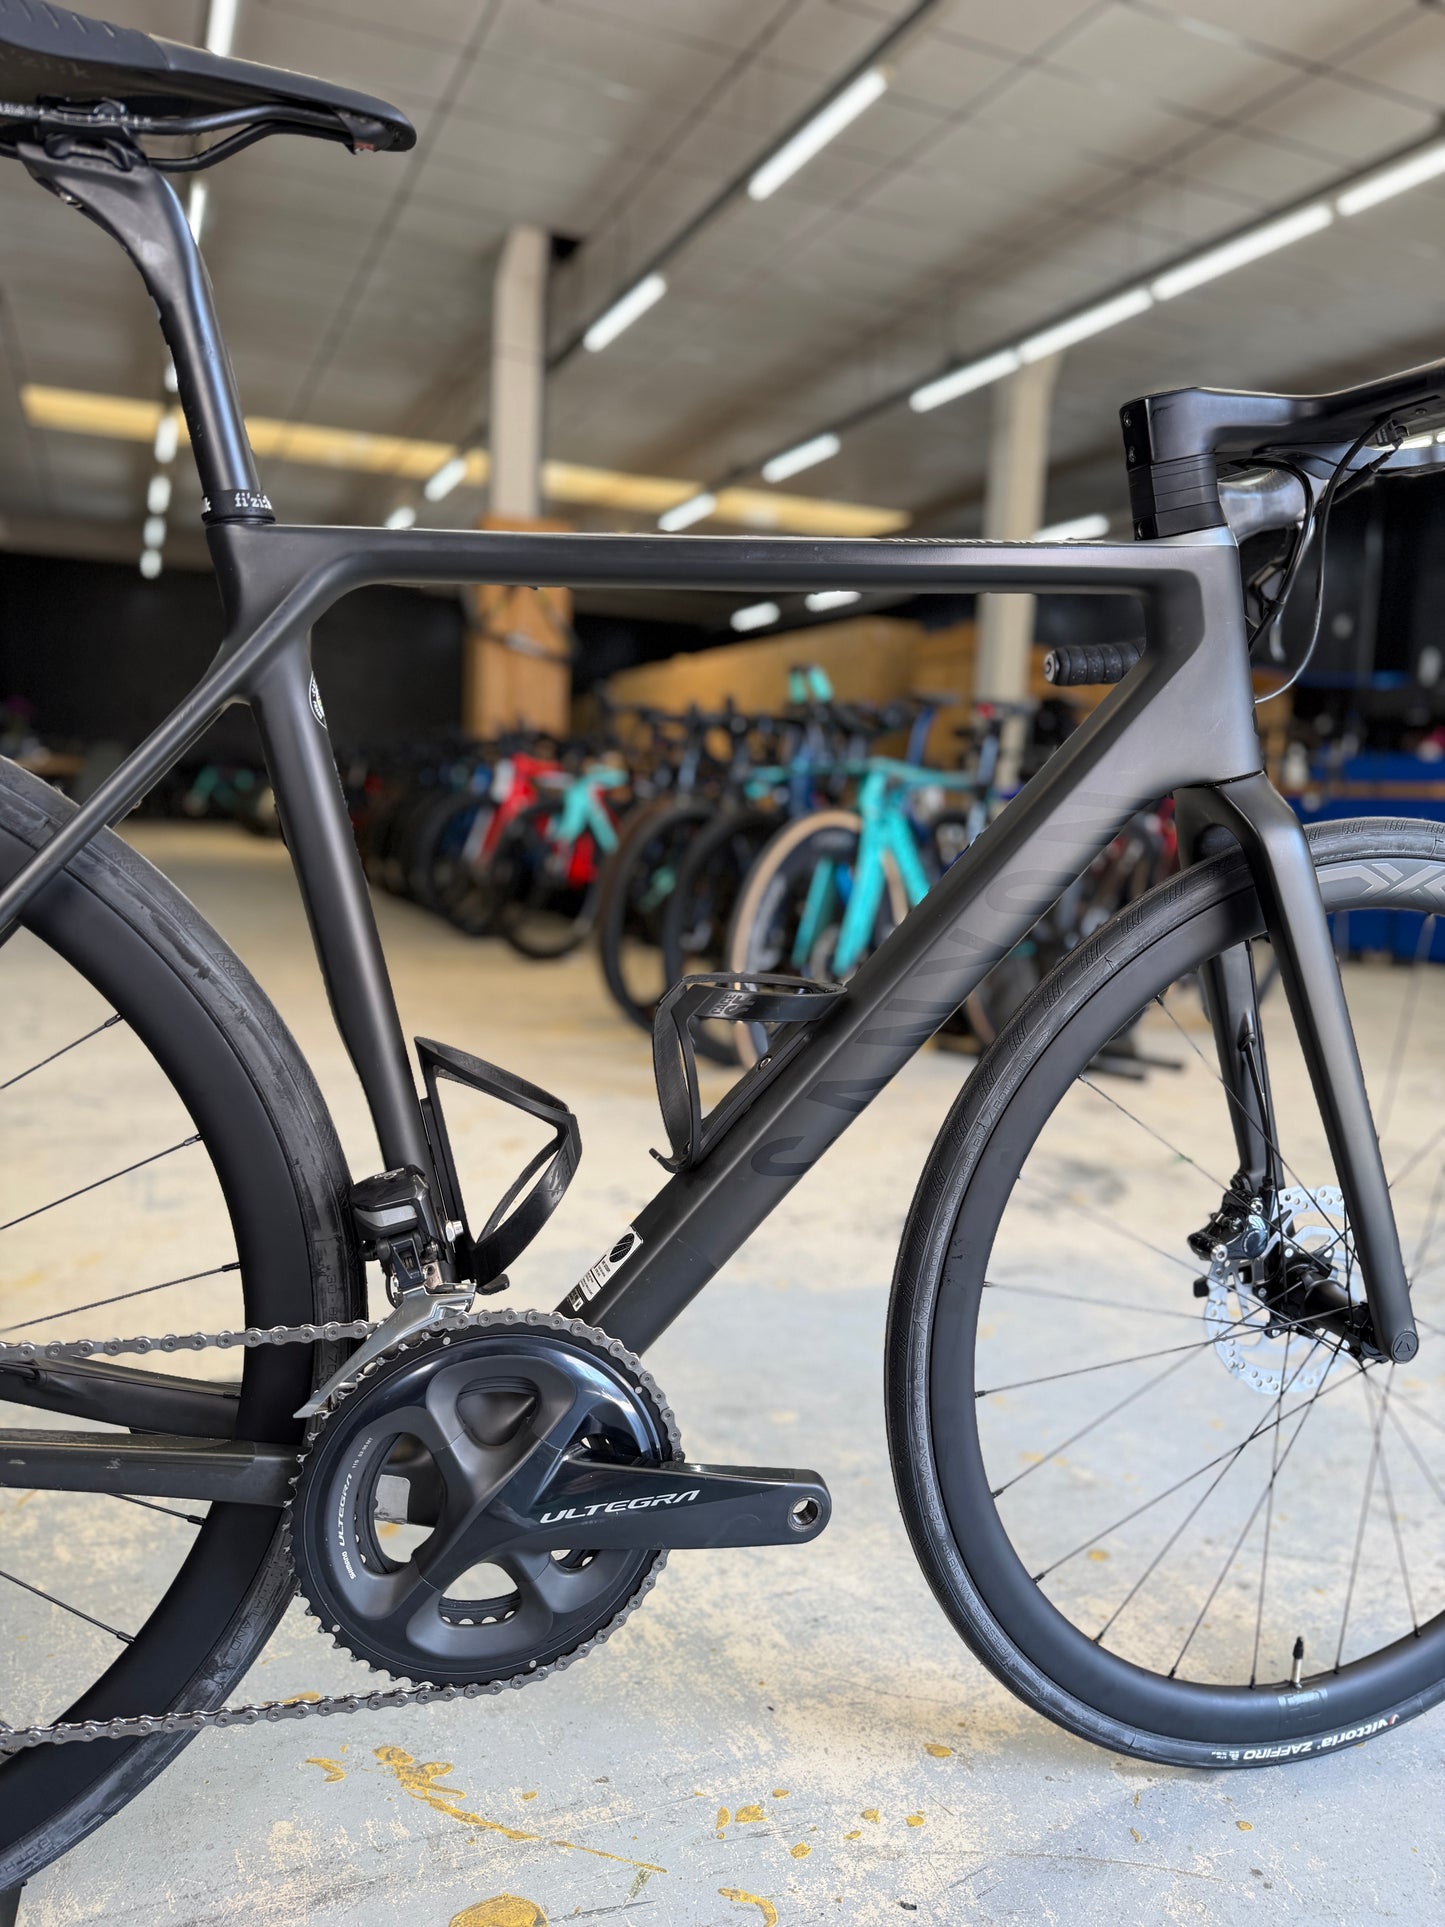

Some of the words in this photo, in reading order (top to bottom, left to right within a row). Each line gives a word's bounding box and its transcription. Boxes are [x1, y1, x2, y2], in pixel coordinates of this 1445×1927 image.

[948, 1149, 977, 1204] HOOKED
[992, 1050, 1035, 1110] ROTATION
[337, 1473, 353, 1547] ULTEGRA
[539, 1489, 701, 1524] ULTEGRA
[1243, 1741, 1313, 1760] ZAFFIRO
[1321, 1718, 1388, 1748] vittoria
